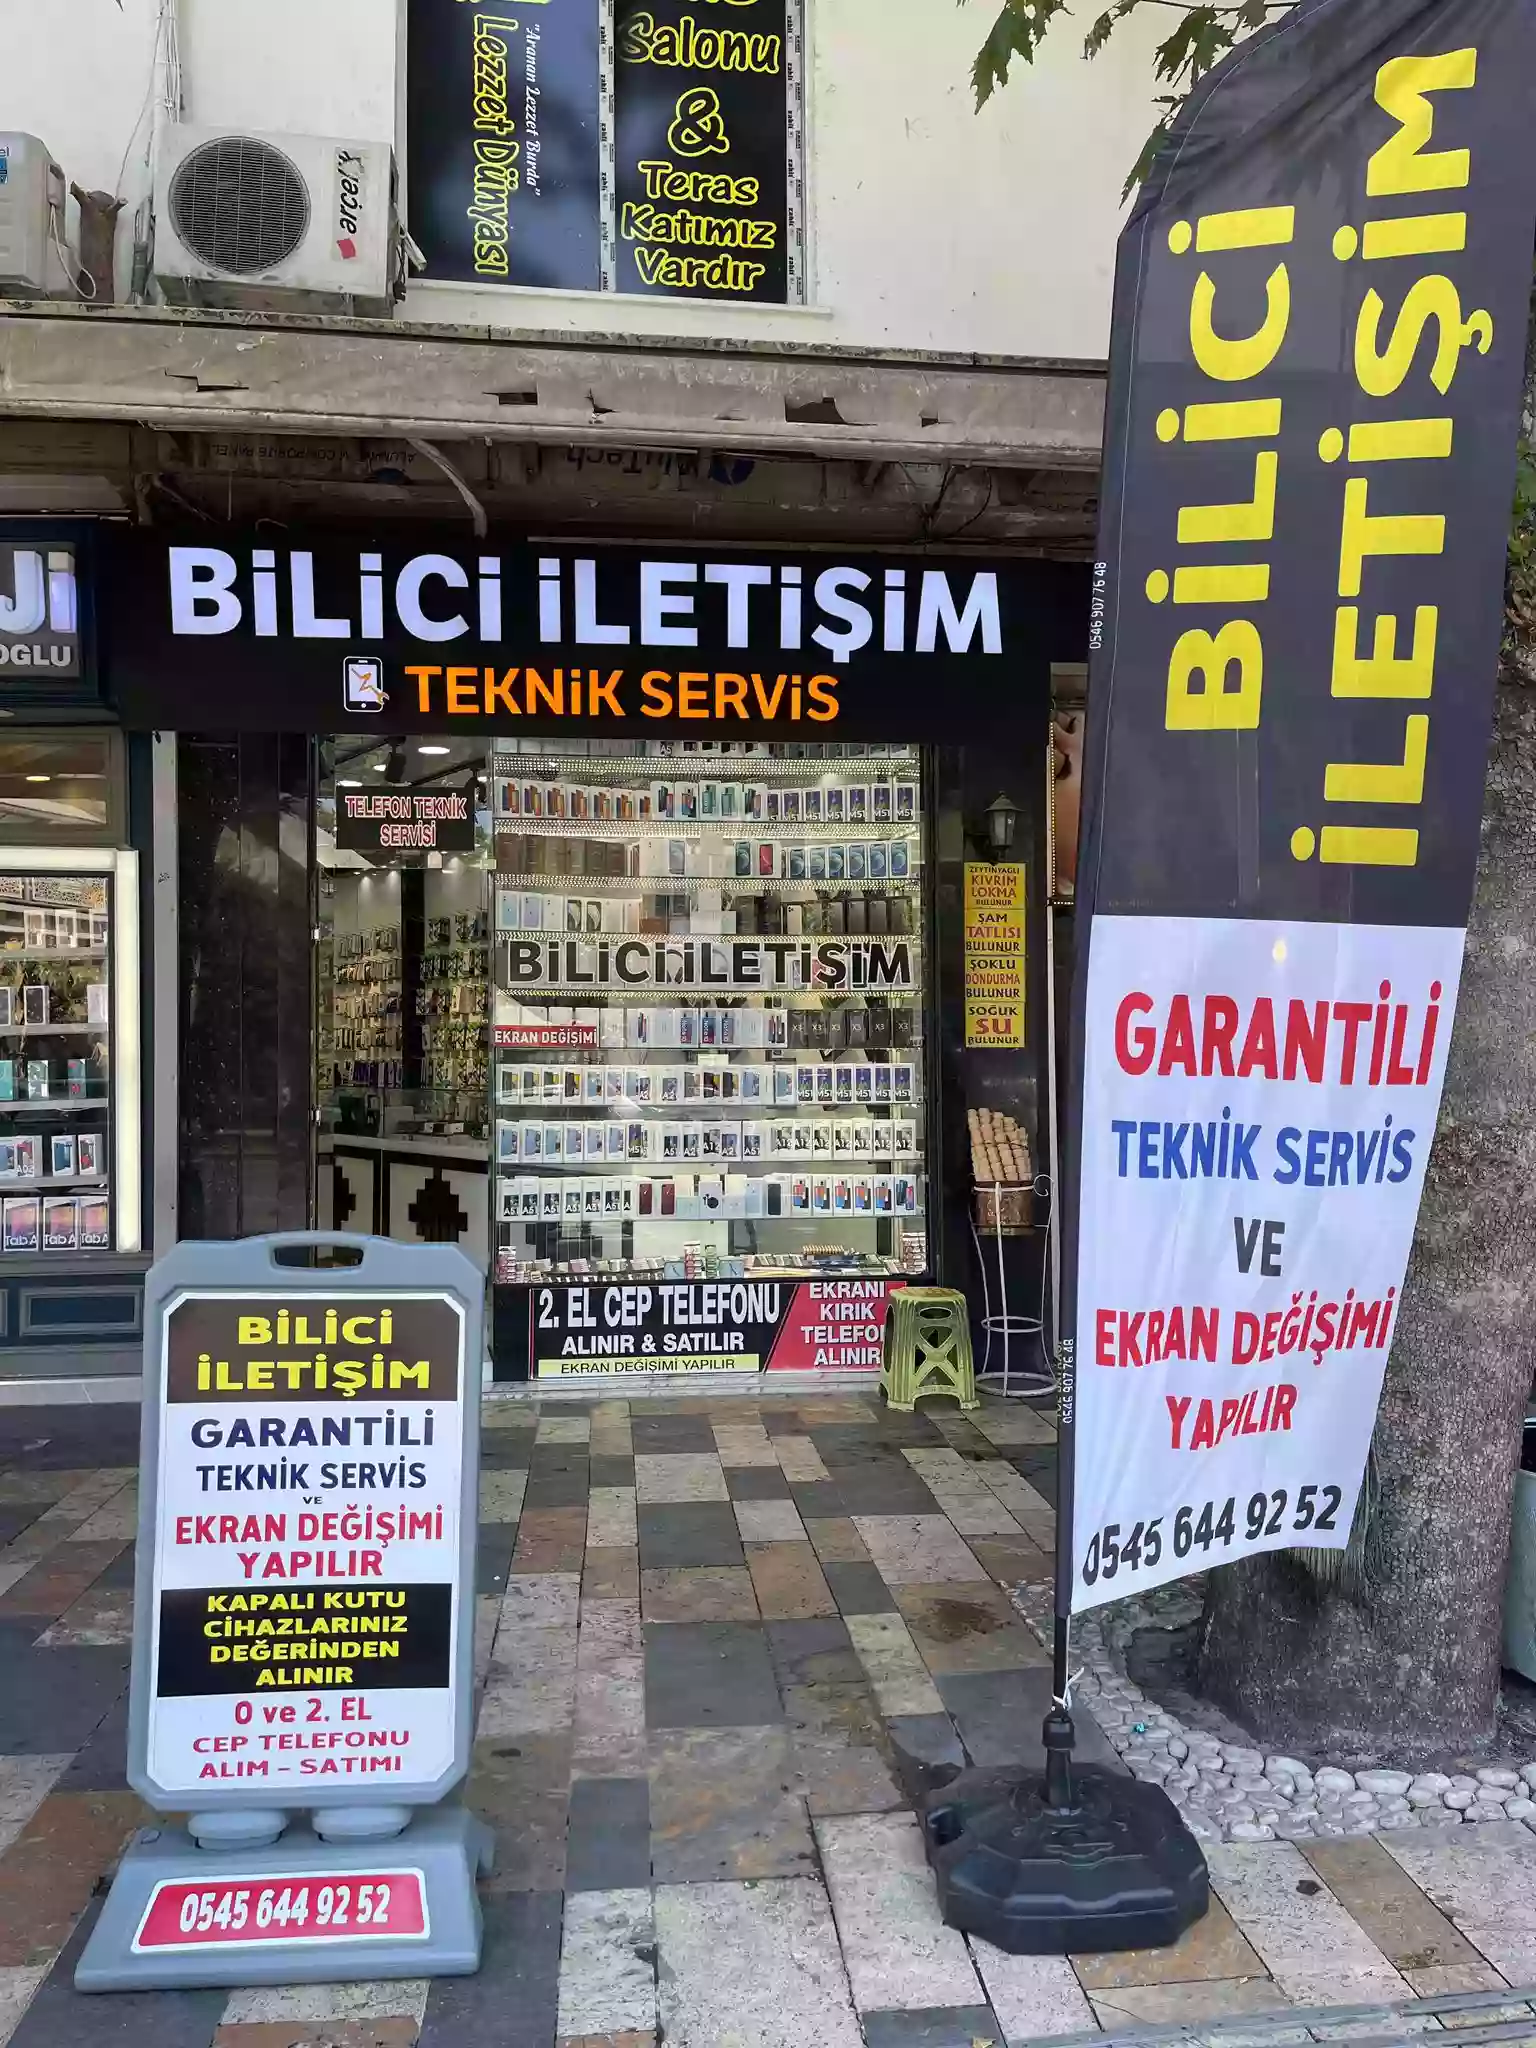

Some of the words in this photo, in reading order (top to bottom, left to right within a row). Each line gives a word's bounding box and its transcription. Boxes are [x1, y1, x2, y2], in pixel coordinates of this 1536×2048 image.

[618, 12, 781, 74] Salonu
[472, 13, 519, 134] Lezzet
[667, 87, 729, 157] &
[638, 160, 759, 205] Teras
[467, 140, 520, 276] Dünyası
[620, 202, 776, 248] Katımız
[634, 247, 765, 291] Vardır
[1091, 597, 1104, 617] 907
[1089, 620, 1102, 649] 0546
[345, 796, 411, 819] TELEFON
[413, 792, 467, 820] TEKNİK
[380, 820, 437, 847] SERVİSİ
[972, 875, 1017, 886] KIVRIM
[972, 887, 1016, 898] LOKMA
[966, 926, 1021, 939] TATLISI
[966, 941, 1020, 952] BULUNUR
[966, 987, 1020, 998] BULUNUR
[494, 1031, 538, 1044] EKRAN
[976, 1018, 1012, 1035] SU
[1114, 979, 1442, 1085] GARANTİLİ
[968, 1036, 1019, 1045] BULUNUR
[1111, 1105, 1262, 1180] TEKNİK
[1273, 1113, 1416, 1187] SERVİS
[5, 1235, 28, 1245] Tab
[45, 1234, 67, 1245] Tab
[1233, 1216, 1285, 1277] VE
[809, 1281, 885, 1299] EKRANI
[538, 1289, 560, 1329] 2.
[567, 1288, 596, 1328] EL
[604, 1286, 652, 1327] CEP
[658, 1284, 780, 1325] TELEFONU
[820, 1303, 875, 1320] KIRIK
[237, 1308, 393, 1345] BİLİCİ
[801, 1325, 885, 1344] TELEFO
[1095, 1306, 1220, 1368] EKRAN
[1231, 1286, 1396, 1366] DEĞİŞİMİ
[562, 1335, 635, 1355] ALINIR
[641, 1334, 656, 1352] &
[663, 1331, 745, 1352] SATILIR
[561, 1360, 611, 1374] EKRAN
[615, 1357, 679, 1374] DEĞİŞİMİ
[683, 1358, 735, 1371] YAPILIR
[814, 1347, 881, 1367] ALINIR
[197, 1353, 430, 1397] İLETİŞİM
[191, 1408, 435, 1448] GARANTİLİ
[1165, 1383, 1298, 1451] YAPILIR
[196, 1456, 310, 1491] TEKNİK
[320, 1455, 427, 1489] SERVİS
[302, 1495, 324, 1505] VE
[176, 1513, 287, 1544] EKRAN
[298, 1504, 444, 1548] DEĞİŞİMİ
[1082, 1516, 1163, 1587] 0545
[1173, 1497, 1236, 1559] 644
[1245, 1489, 1288, 1539] 92
[1293, 1485, 1343, 1530] 52
[237, 1550, 383, 1578] YAPILIR
[207, 1593, 315, 1612] KAPALI
[324, 1591, 406, 1609] KUTU
[203, 1615, 408, 1638] CİHAZLARINIZ
[210, 1638, 400, 1663] DEĞERİNDEN
[256, 1666, 354, 1686] ALINIR
[263, 1704, 296, 1724] ve
[306, 1698, 330, 1722] 2.
[341, 1697, 372, 1721] EL
[193, 1736, 248, 1753] CEP
[258, 1730, 410, 1750] TELEFONU
[199, 1760, 269, 1778] ALIM
[300, 1755, 401, 1775] SATIMI
[179, 1893, 249, 1932] 0545
[256, 1887, 309, 1928] 644
[316, 1884, 349, 1925] 92
[356, 1884, 391, 1923] 52
